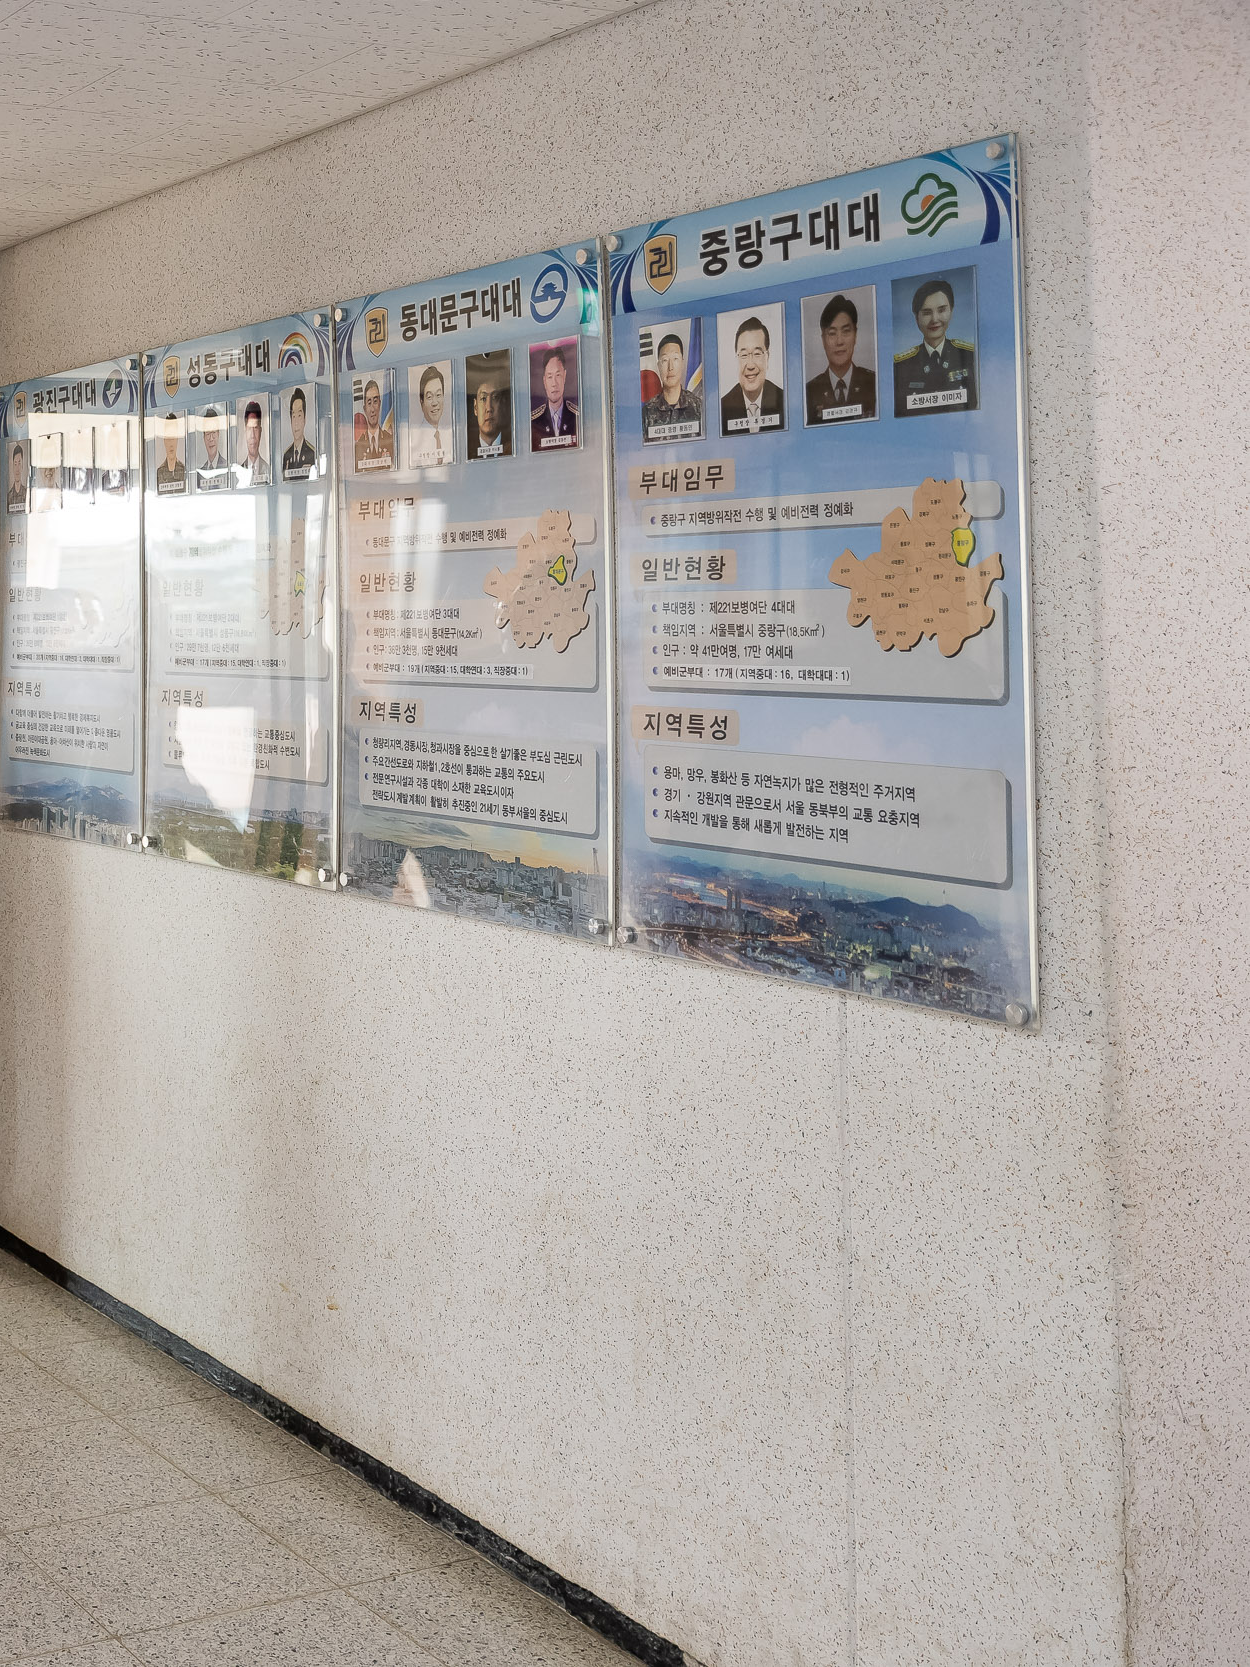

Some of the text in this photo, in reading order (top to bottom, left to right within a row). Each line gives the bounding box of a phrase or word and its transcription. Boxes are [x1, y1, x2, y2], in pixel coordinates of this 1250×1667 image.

[699, 192, 880, 277] 중랑구대대
[400, 277, 522, 342] 동대문구대대
[187, 339, 270, 388] 성동구대대
[911, 392, 962, 406] 소방서장 이미자
[639, 465, 724, 495] 부대임무
[660, 501, 854, 528] 중랑구 지역방위작전 수행 및 예비전력 정예화
[372, 536, 395, 548] 동대문구
[450, 532, 456, 544] 및
[459, 530, 484, 543] 예비전력
[487, 528, 507, 542] 정예화
[642, 555, 726, 582] 일반현황
[360, 571, 416, 593] 일반현황
[443, 608, 459, 619] 3대대
[662, 601, 696, 615] 부대명칭
[709, 600, 767, 615] 제221보병여단
[771, 600, 795, 614] 4대대
[400, 627, 430, 639] 서울특별시
[662, 623, 696, 637] 책임지역
[709, 623, 754, 638] 서울특별시
[435, 644, 458, 657] 9천세대
[662, 643, 679, 657] 인구
[690, 644, 699, 658] 약
[702, 644, 740, 659] 41만여명,
[744, 645, 761, 659] 17만
[765, 645, 793, 659] 여세대
[373, 663, 400, 673] 예비군부대
[407, 664, 420, 674] 19개
[460, 665, 482, 675] 대학연대
[493, 666, 517, 676] 직장중대
[663, 666, 703, 678] 예비군부대
[715, 668, 733, 679] 17개
[780, 669, 793, 680] 16,
[798, 669, 833, 682] 대학대대
[841, 670, 850, 681] 1)
[7, 681, 41, 698] 지역특성
[161, 689, 203, 708] 지역특성
[359, 701, 416, 724] 지역특성
[264, 729, 295, 742] 교통중심도시
[643, 712, 728, 740] 지역특성
[280, 746, 300, 757] 수변도시
[529, 750, 551, 764] 부도심
[553, 751, 582, 767] 근린도시
[465, 764, 492, 778] 통과하는
[494, 767, 514, 780] 교통의
[517, 769, 545, 783] 주요도시
[416, 777, 429, 790] 각종
[431, 779, 450, 792] 대학이
[452, 781, 471, 794] 소재한
[663, 765, 915, 803] 용마, 망우, 봉화산 등 자연녹지가 많은 전형적인 주거지역
[430, 795, 449, 810] 활발히
[451, 798, 477, 813] 추진중인
[480, 802, 499, 816] 21세기
[539, 809, 567, 825] 중심도시
[664, 788, 681, 802] 경기
[697, 791, 732, 808] 강원지역
[735, 795, 781, 813] 관문으로서
[785, 800, 805, 816] 서울
[809, 802, 848, 820] 동북부의
[852, 807, 873, 823] 교통
[877, 809, 920, 828] 요충지역
[664, 809, 848, 844] 지속적인 개발을 통해 새롭게 발전하는 지역
